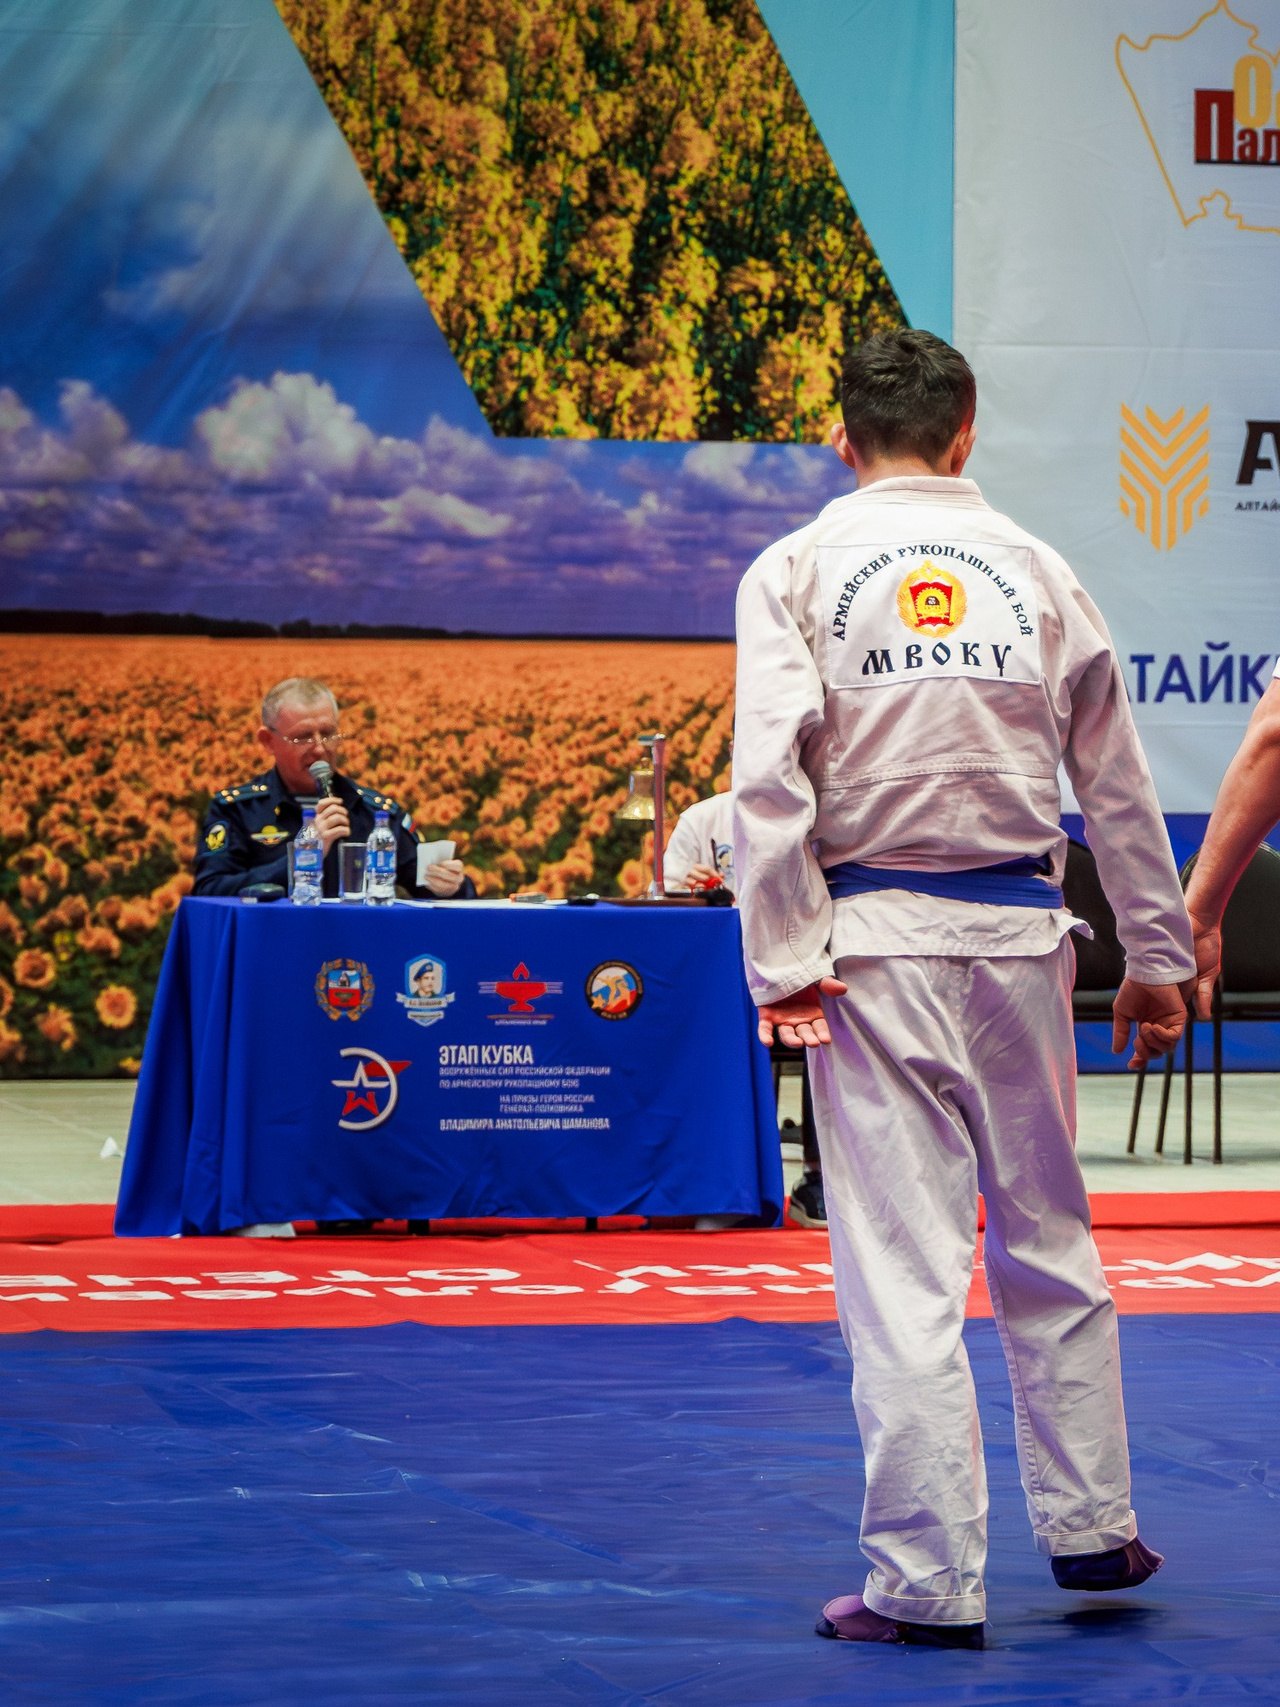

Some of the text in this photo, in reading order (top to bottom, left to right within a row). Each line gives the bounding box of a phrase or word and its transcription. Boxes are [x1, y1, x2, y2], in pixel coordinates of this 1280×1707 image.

[832, 544, 1034, 641] АРМЕЙСКИЙ РУКОПАШНЫЙ БОЙ
[862, 641, 1011, 676] МВОКУ
[439, 1045, 534, 1065] ЭТАП КУБКА
[498, 1066, 513, 1075] СИЛ
[515, 1065, 563, 1076] РОССИЙСКОЙ
[565, 1066, 611, 1076] ФЕДЕРАЦИИ
[439, 1078, 580, 1088] ПО АРМЕЙСКОМУ РУКОПАШНОМУ БОЮ
[500, 1095, 510, 1103] НА
[512, 1095, 537, 1103] ПРИЗЫ
[540, 1095, 562, 1103] ГЕРОЯ
[440, 1118, 610, 1131] ВЛАДИМИРА АНАТОЛЬЕВИЧА ШАМАНОВА
